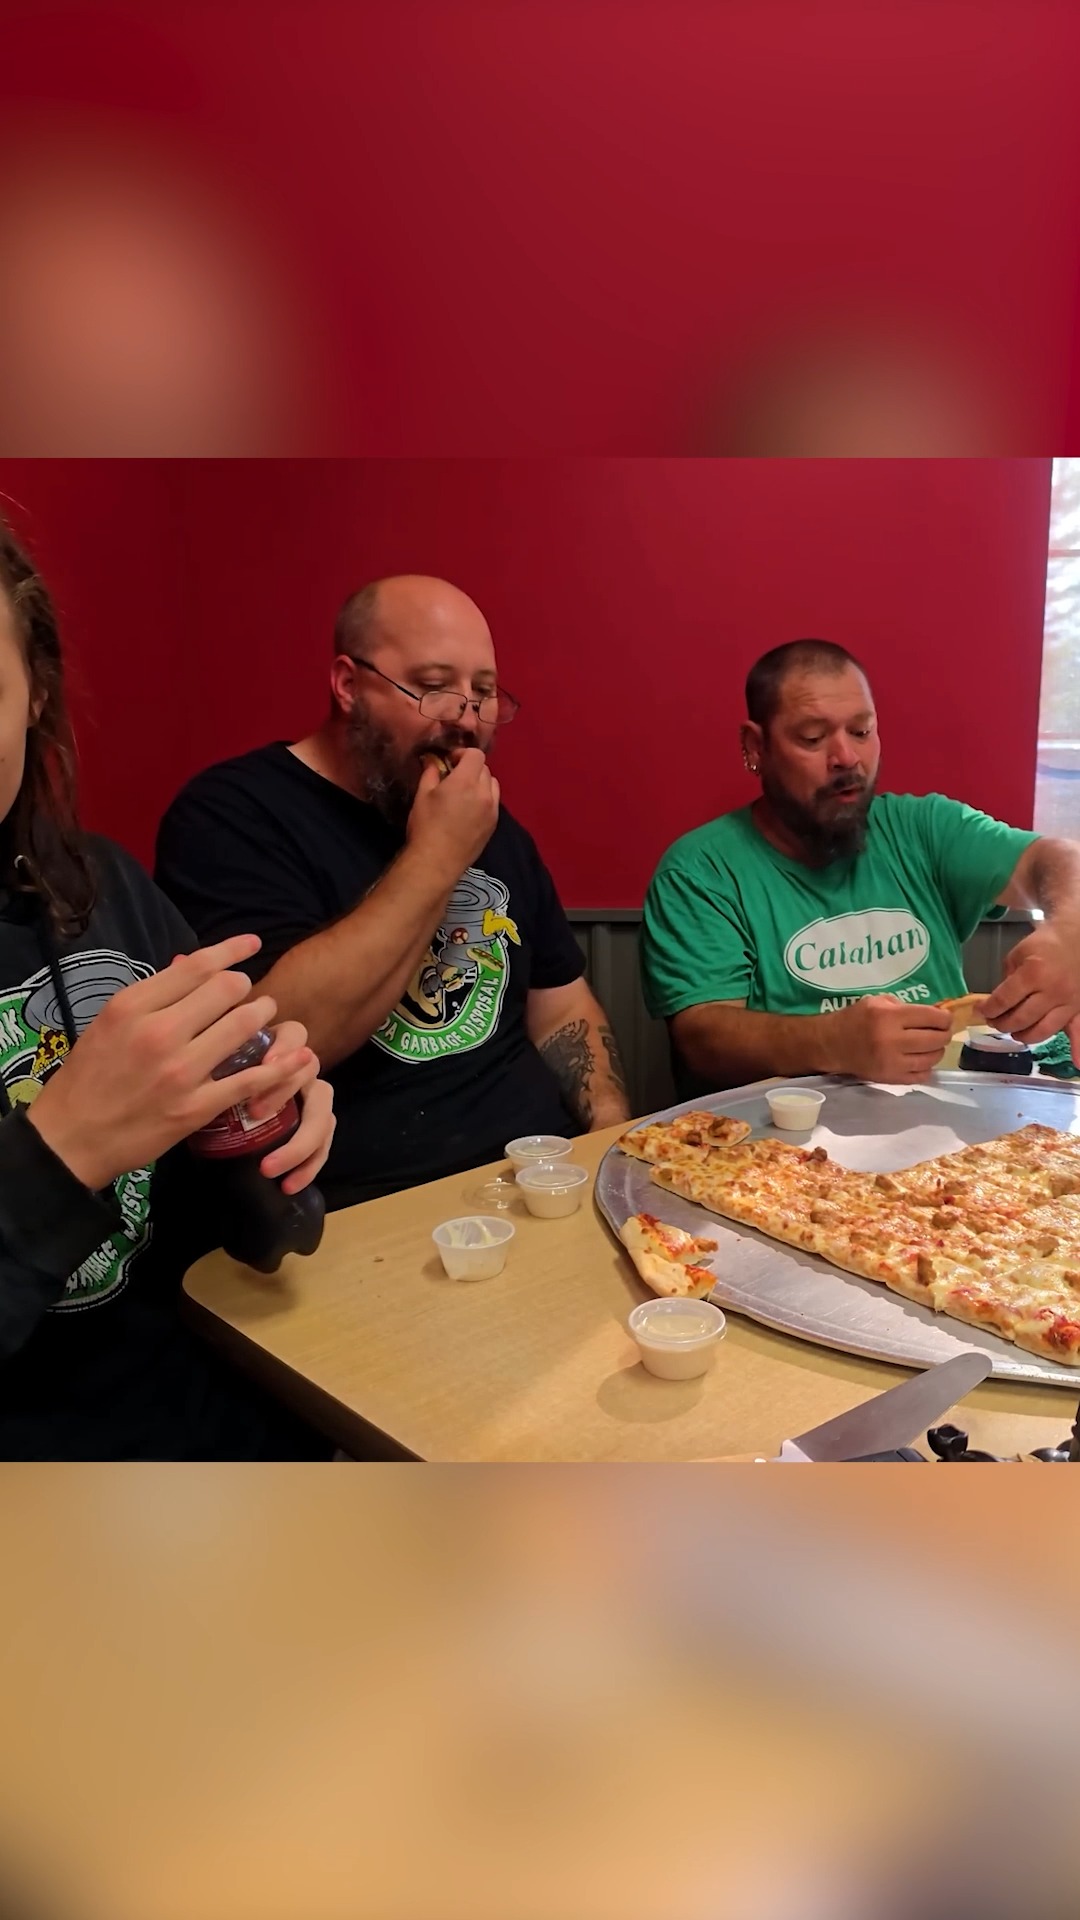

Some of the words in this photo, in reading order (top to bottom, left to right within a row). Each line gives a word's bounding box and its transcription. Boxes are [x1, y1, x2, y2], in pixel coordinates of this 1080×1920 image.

[400, 1031, 468, 1054] GARBAGE
[459, 977, 500, 1038] DISPOSAL
[879, 984, 930, 1003] RTS
[120, 1168, 152, 1241] DISPO
